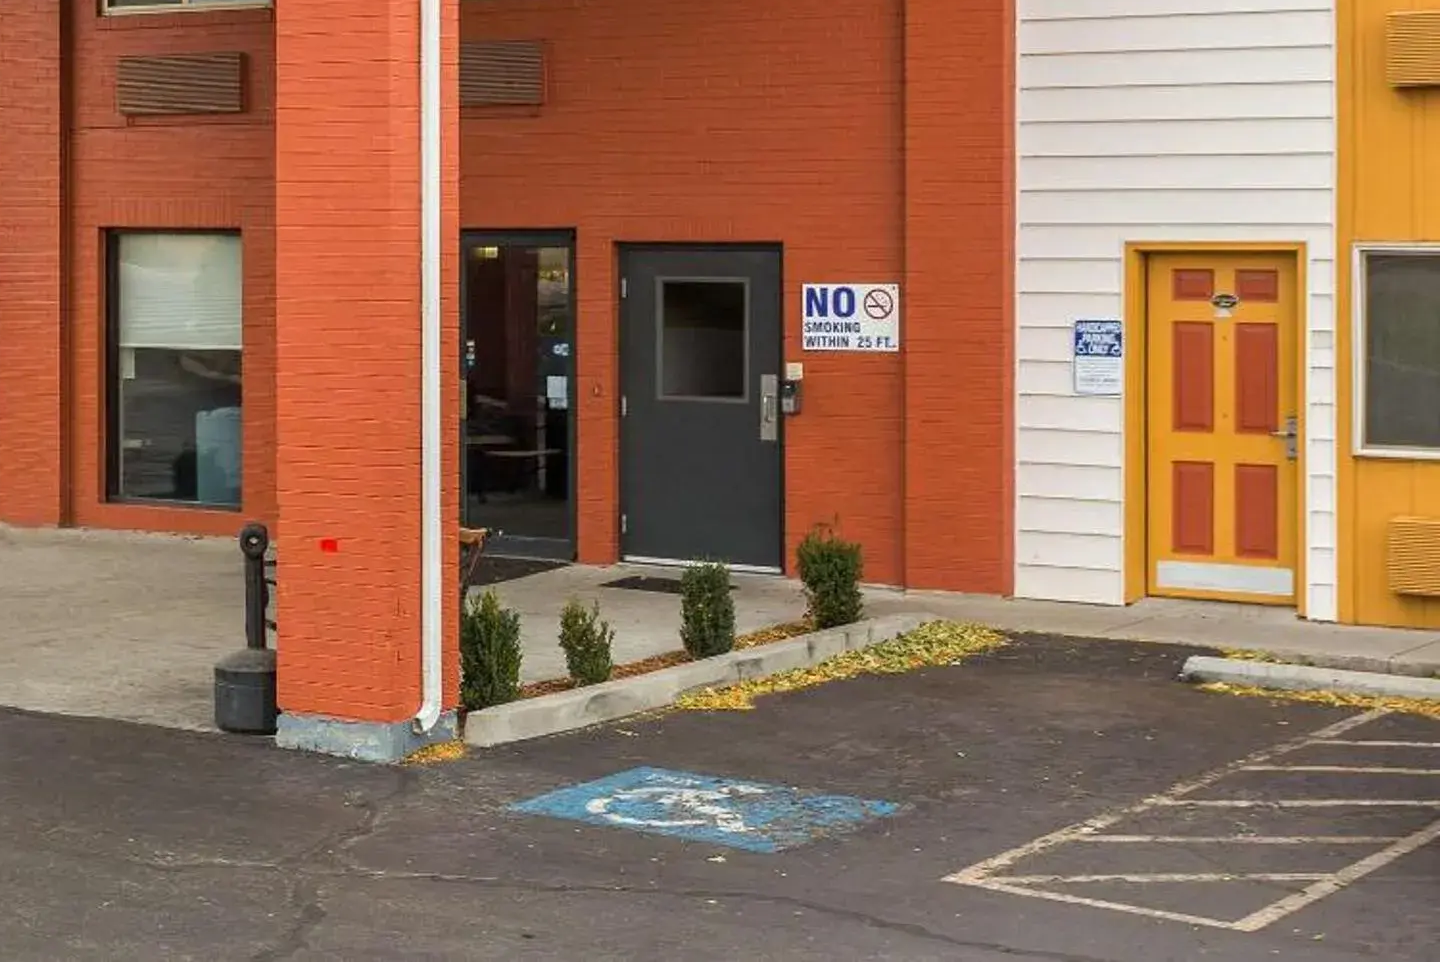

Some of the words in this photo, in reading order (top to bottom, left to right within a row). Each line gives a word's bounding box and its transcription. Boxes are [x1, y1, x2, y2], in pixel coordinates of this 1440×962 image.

[806, 286, 855, 318] NO
[804, 321, 861, 333] SMOKING
[804, 336, 850, 348] WITHIN
[857, 336, 872, 348] 25
